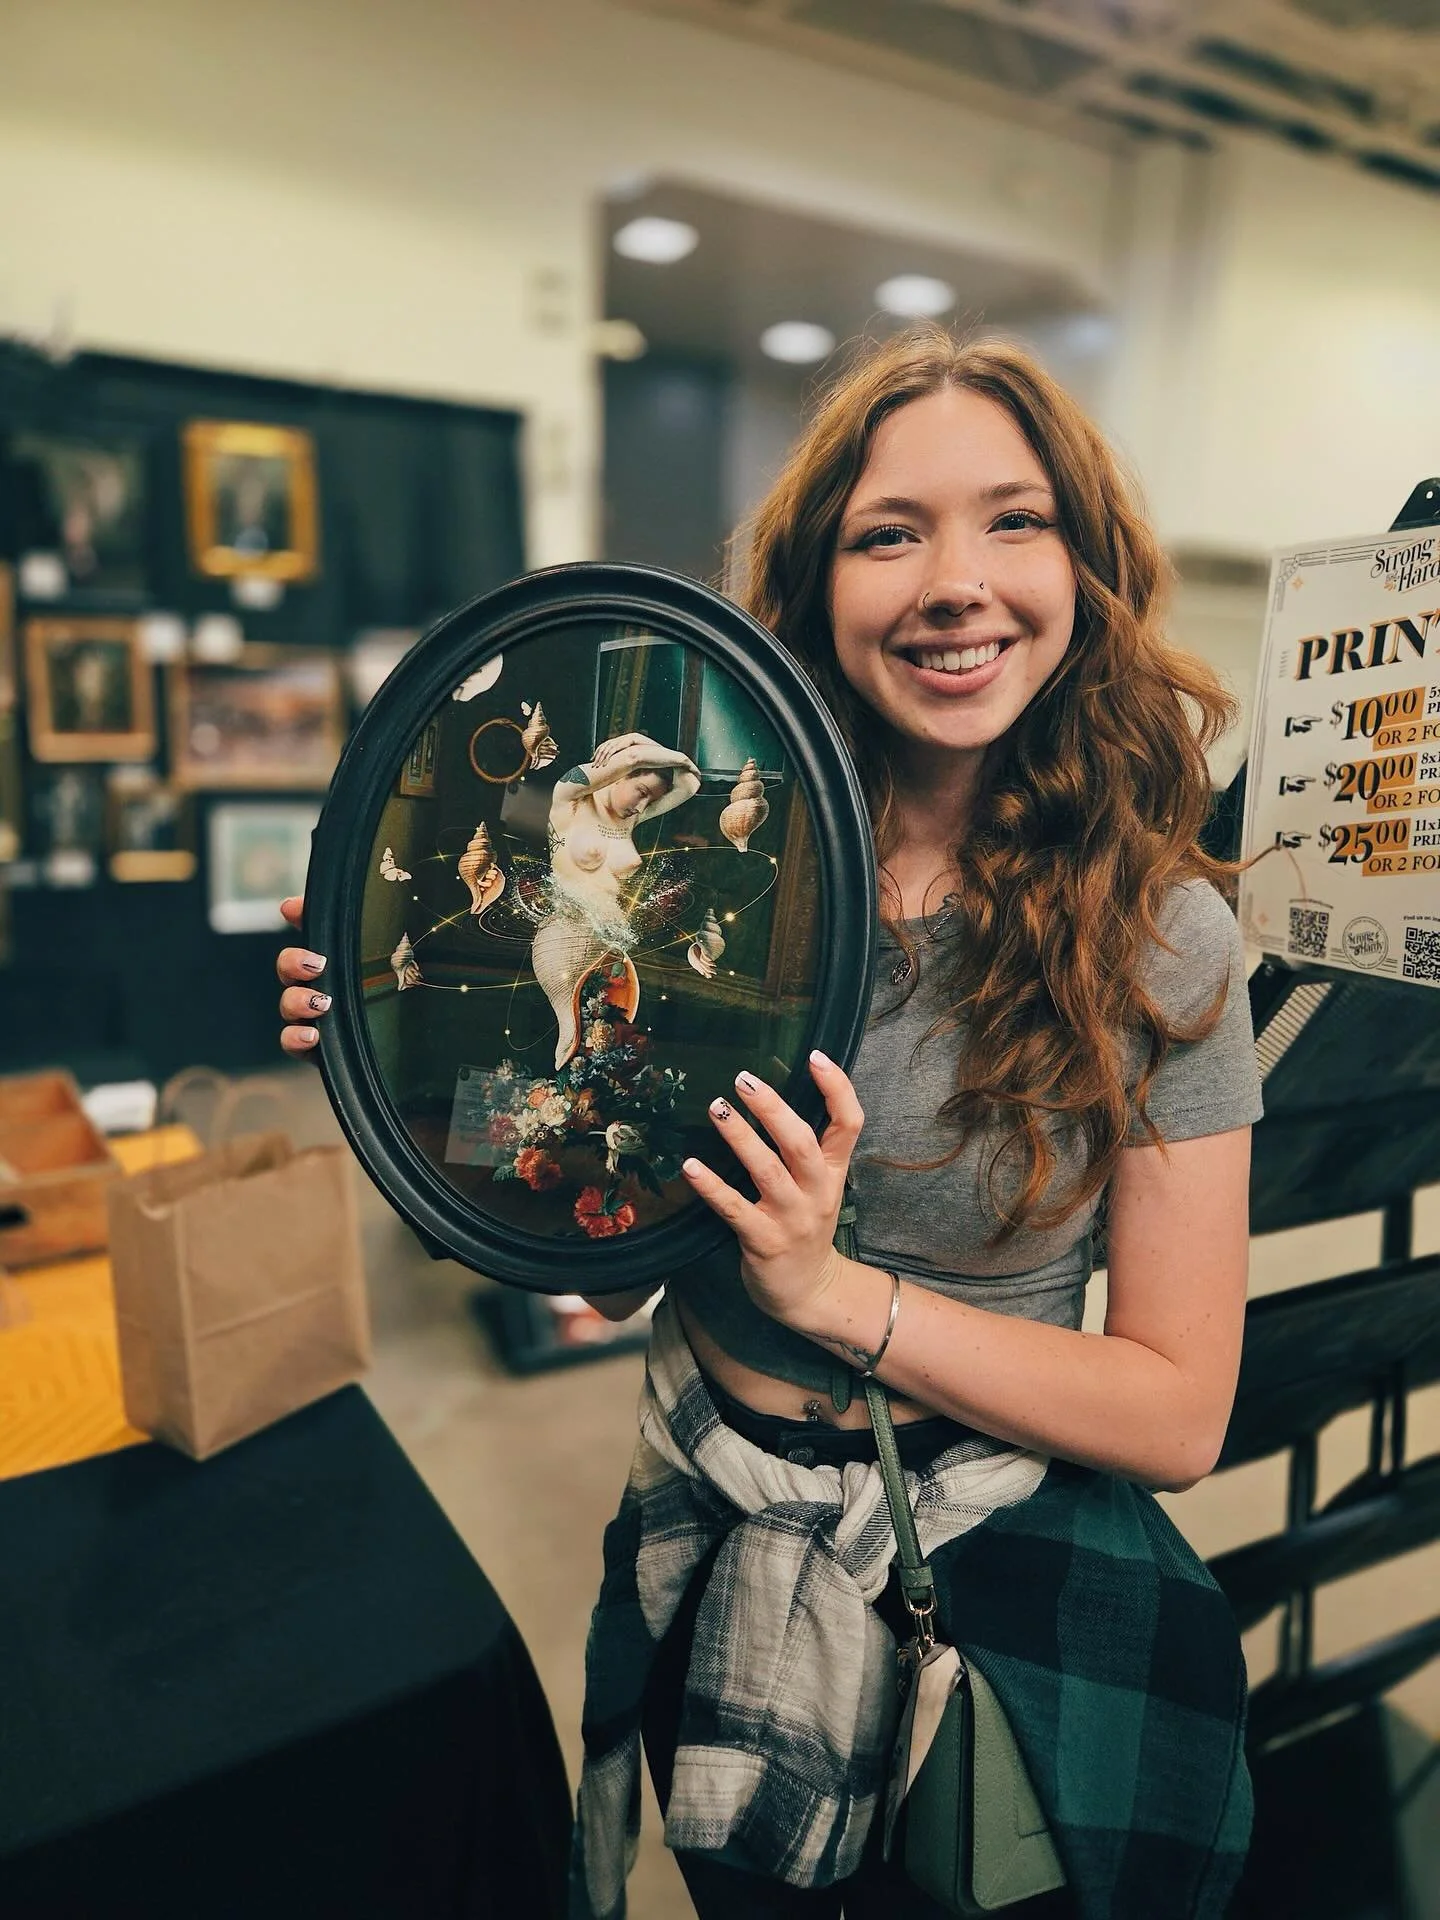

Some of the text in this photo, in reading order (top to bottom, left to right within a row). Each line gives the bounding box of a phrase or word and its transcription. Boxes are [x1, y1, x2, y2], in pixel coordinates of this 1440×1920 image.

[1371, 538, 1436, 578] Strong
[1429, 686, 1440, 699] 5
[1377, 729, 1401, 746] OR
[1407, 727, 1417, 742] 2
[1420, 766, 1440, 780] PR
[1373, 792, 1398, 809] OR
[1403, 791, 1412, 806] 2
[1412, 833, 1440, 847] PRI
[1369, 857, 1392, 873] OR
[1397, 856, 1407, 871] 2
